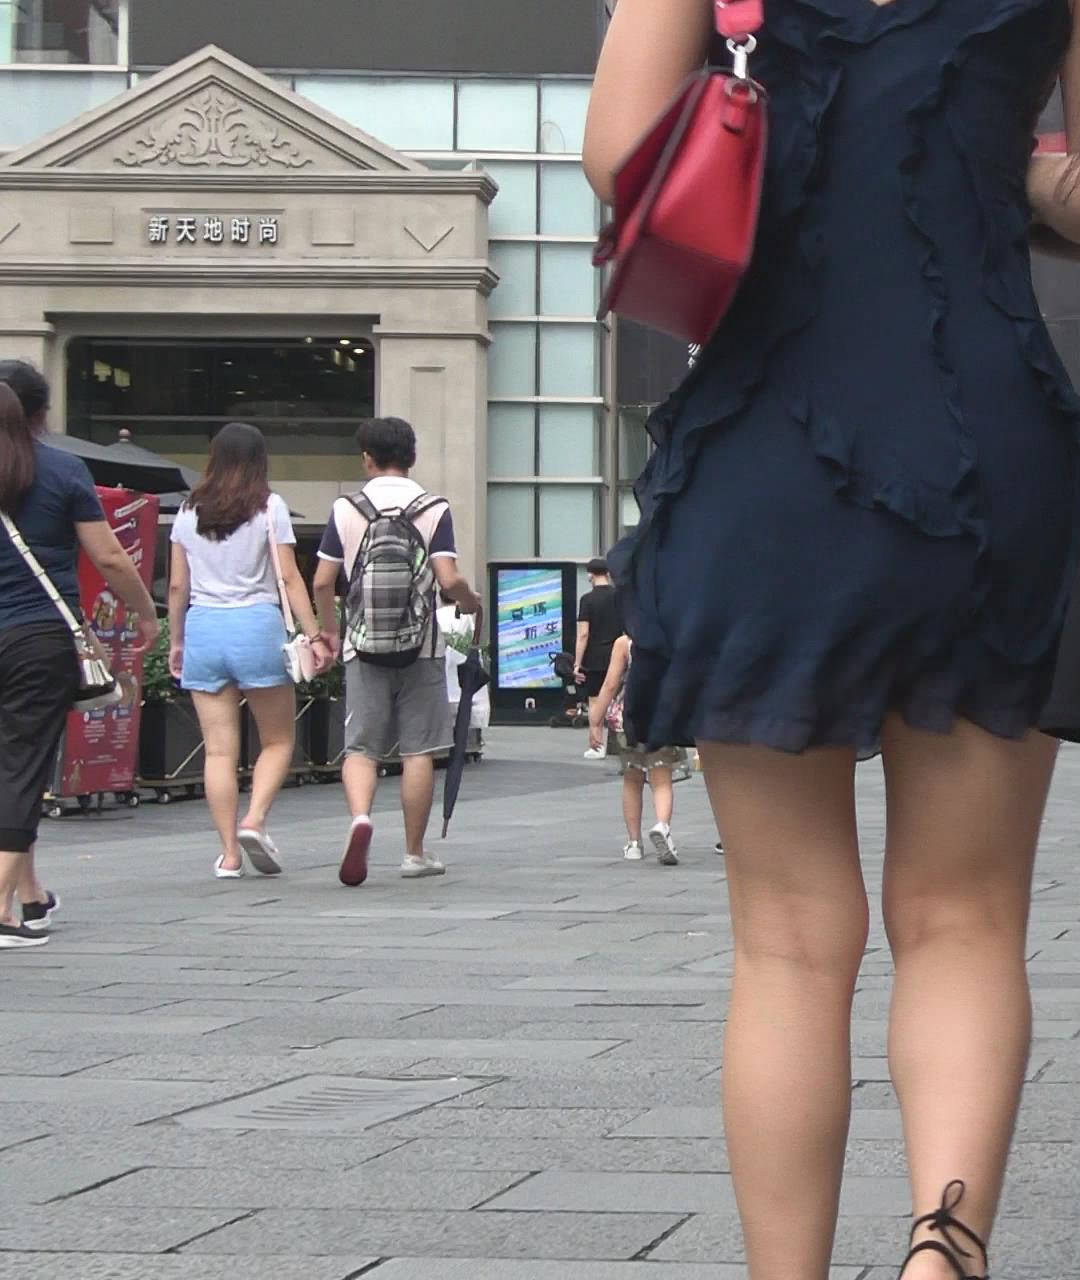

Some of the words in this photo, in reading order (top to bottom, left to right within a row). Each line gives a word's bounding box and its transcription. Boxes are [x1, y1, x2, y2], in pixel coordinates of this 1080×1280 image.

[148, 216, 278, 243] 新天地时尚
